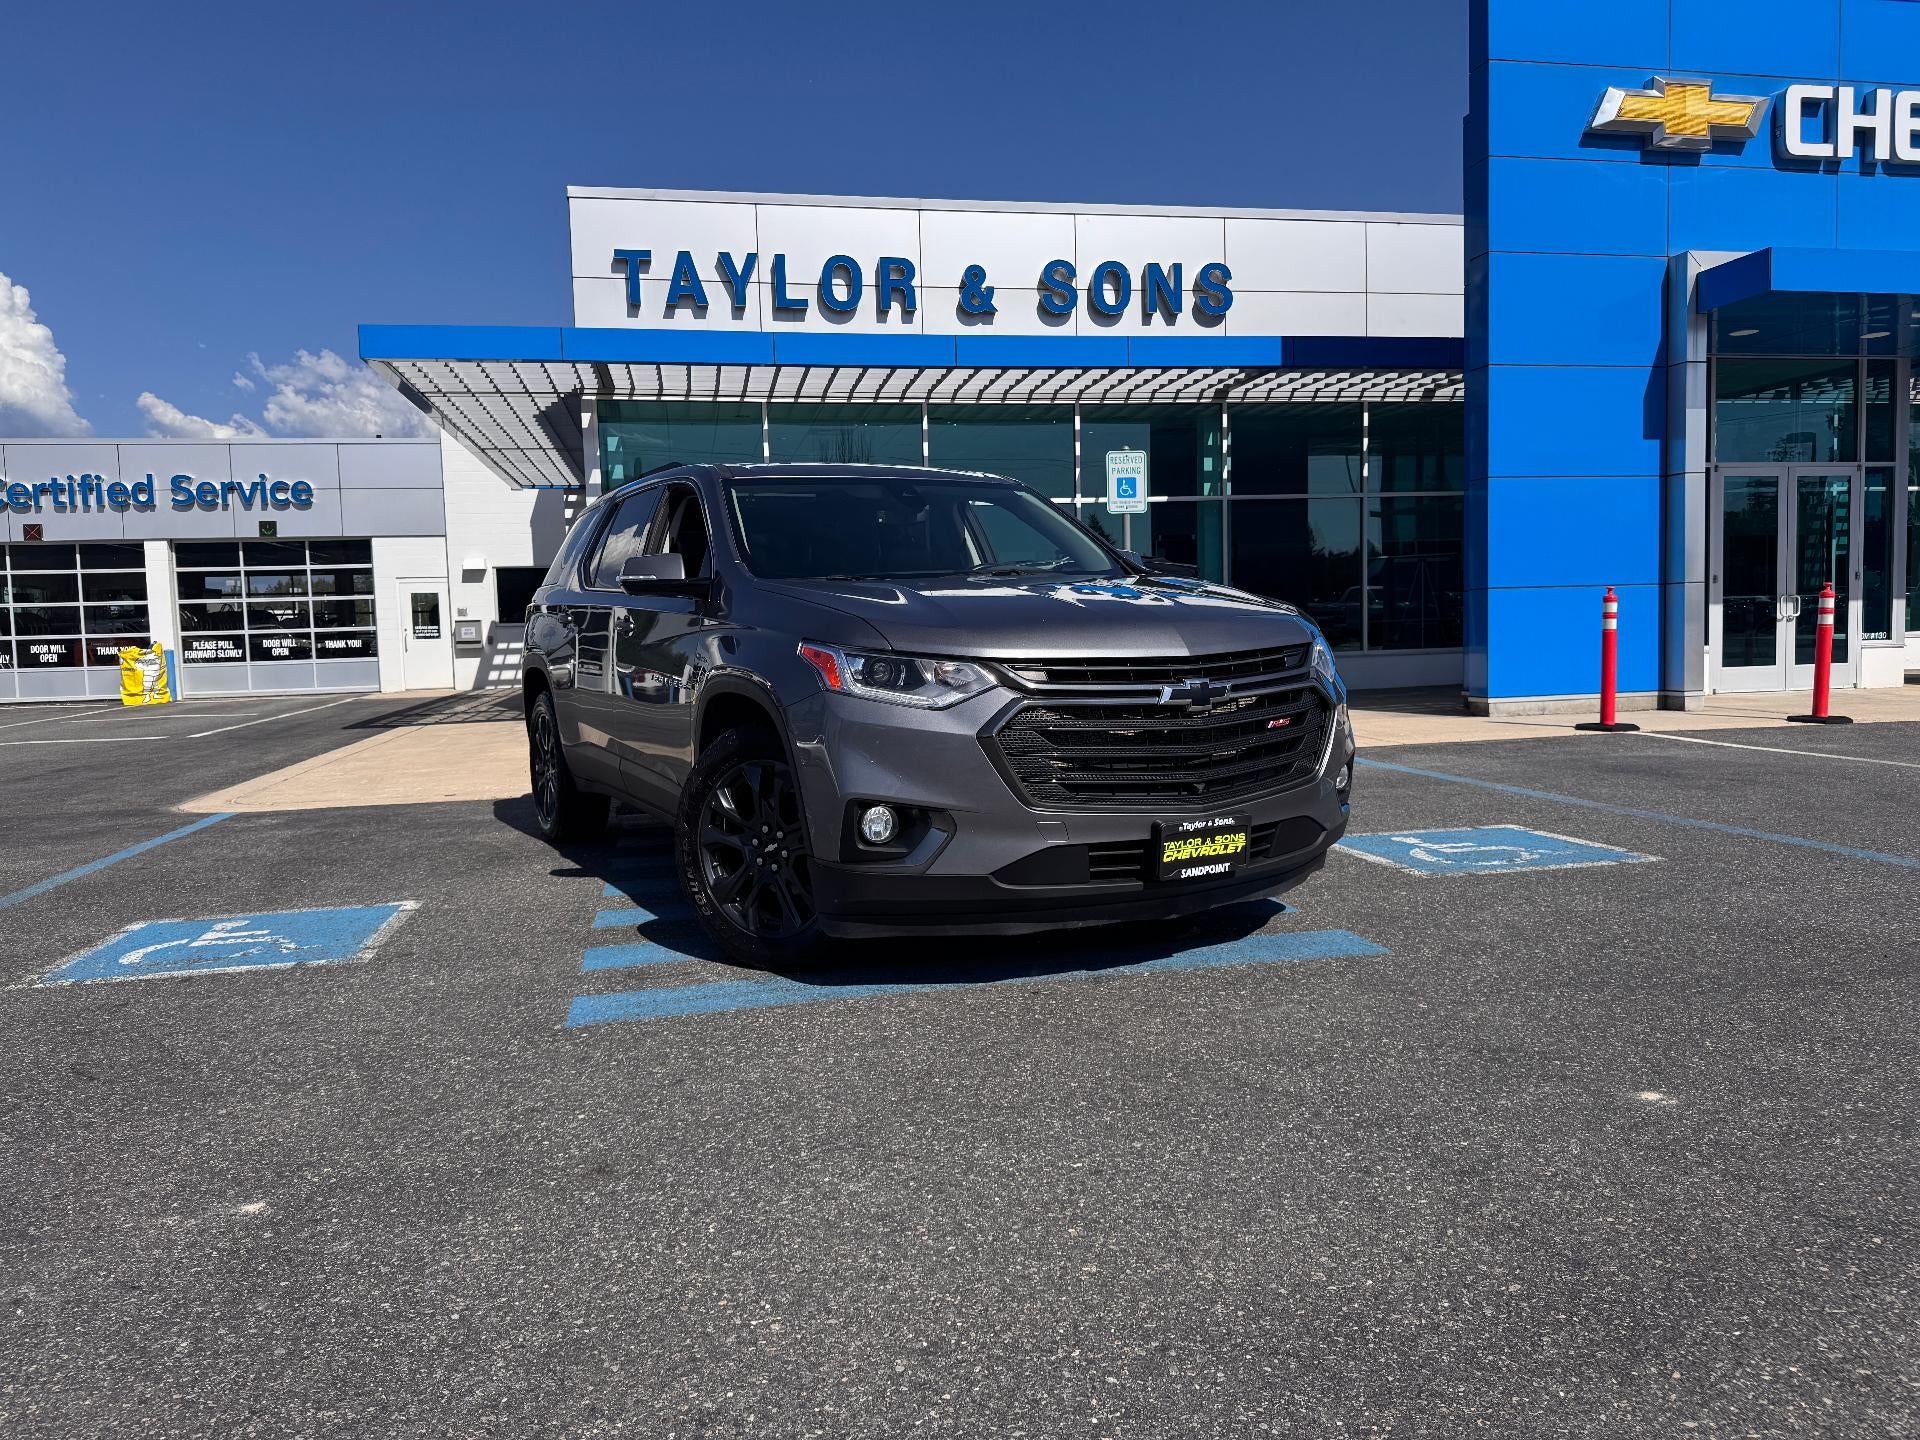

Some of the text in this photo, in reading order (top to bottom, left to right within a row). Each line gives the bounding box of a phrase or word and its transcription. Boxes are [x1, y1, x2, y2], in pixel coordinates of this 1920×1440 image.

[1786, 85, 1920, 160] CHE
[613, 249, 1233, 315] TAYLOR & SONS
[1110, 456, 1143, 465] RESERVED
[1111, 467, 1141, 475] PARKING
[0, 473, 314, 508] ertified Service
[193, 640, 234, 649] PLEASE PULL
[262, 638, 297, 648] DOOR WILL
[325, 639, 362, 648] THANK YOU!
[30, 644, 67, 654] DOOR WILL
[96, 646, 119, 656] THANK
[184, 649, 242, 659] FORWARD SLOWLY
[271, 648, 289, 656] OPEN
[40, 653, 58, 663] OPEN
[1182, 820, 1206, 832] Taylor
[1213, 817, 1233, 827] Sons
[1164, 832, 1246, 851] TAYLOR & SONS
[1163, 842, 1246, 863] CHEVROLET
[1180, 862, 1231, 878] SANDPOINT
